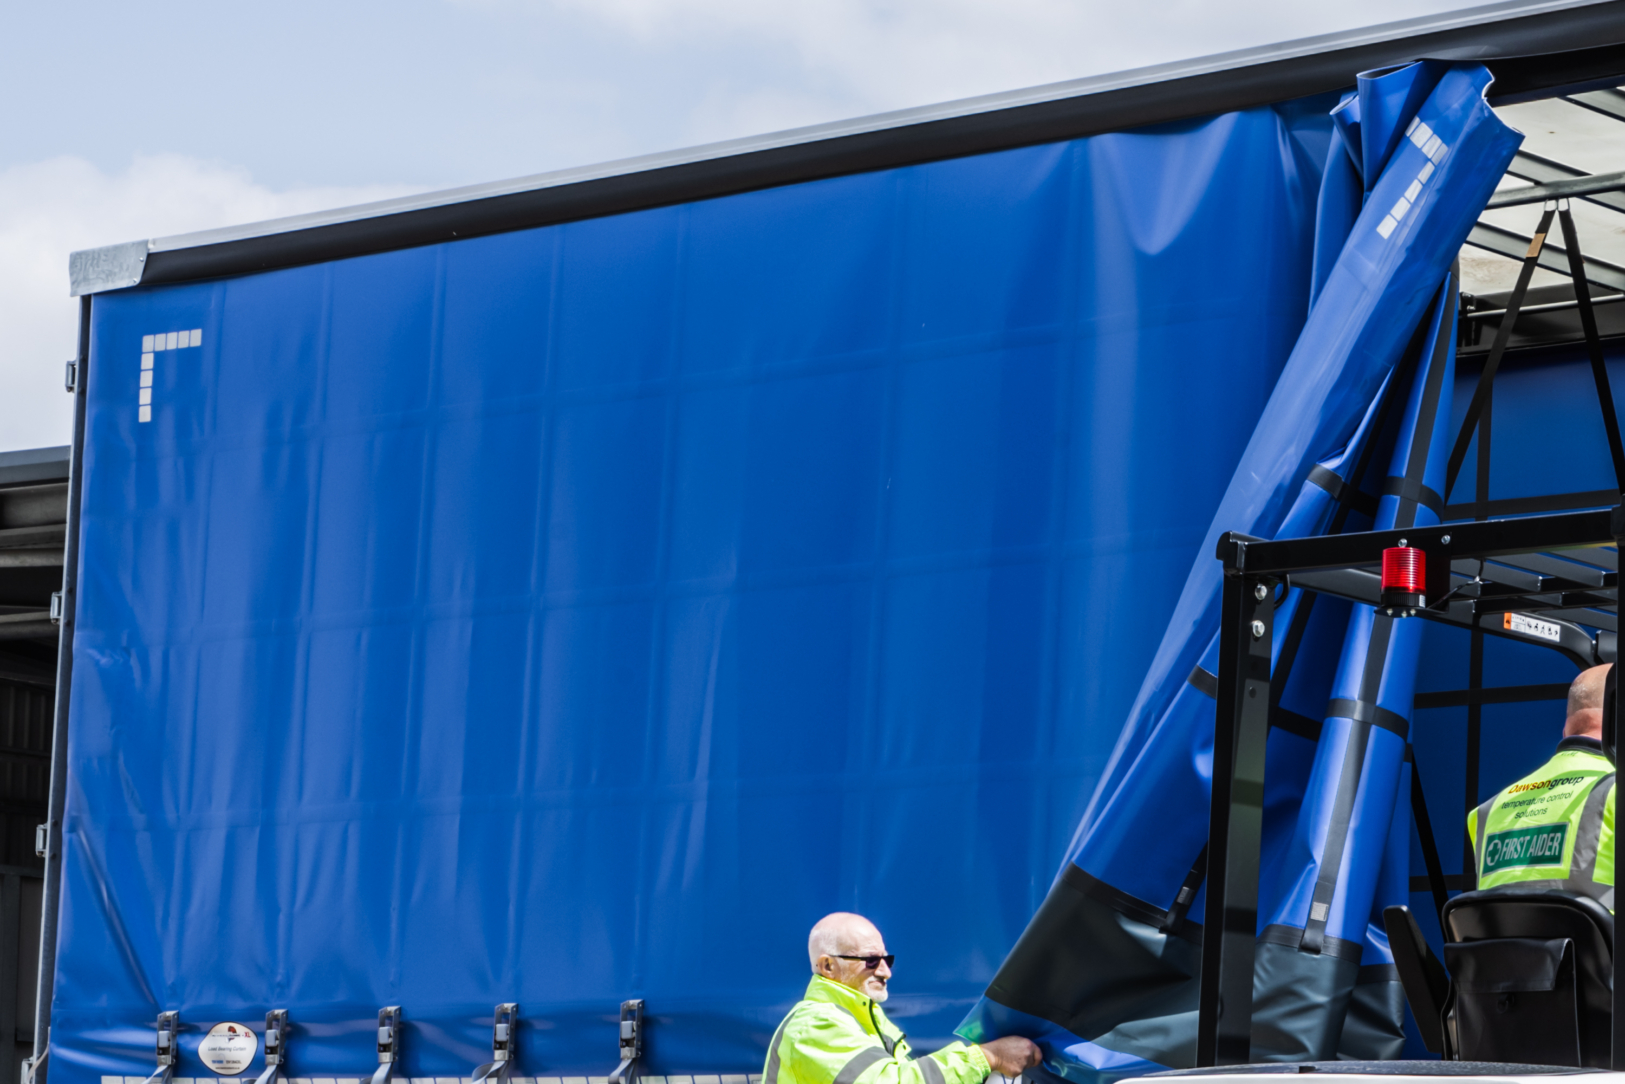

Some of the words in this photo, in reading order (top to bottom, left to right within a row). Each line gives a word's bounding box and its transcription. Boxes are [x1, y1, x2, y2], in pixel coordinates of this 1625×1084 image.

[1508, 776, 1584, 794] Dawsongroup
[1501, 796, 1545, 809] temperature
[1546, 791, 1574, 804] control
[1514, 807, 1548, 819] solutions
[1500, 836, 1529, 861] FIRST
[1529, 832, 1561, 857] AIDER
